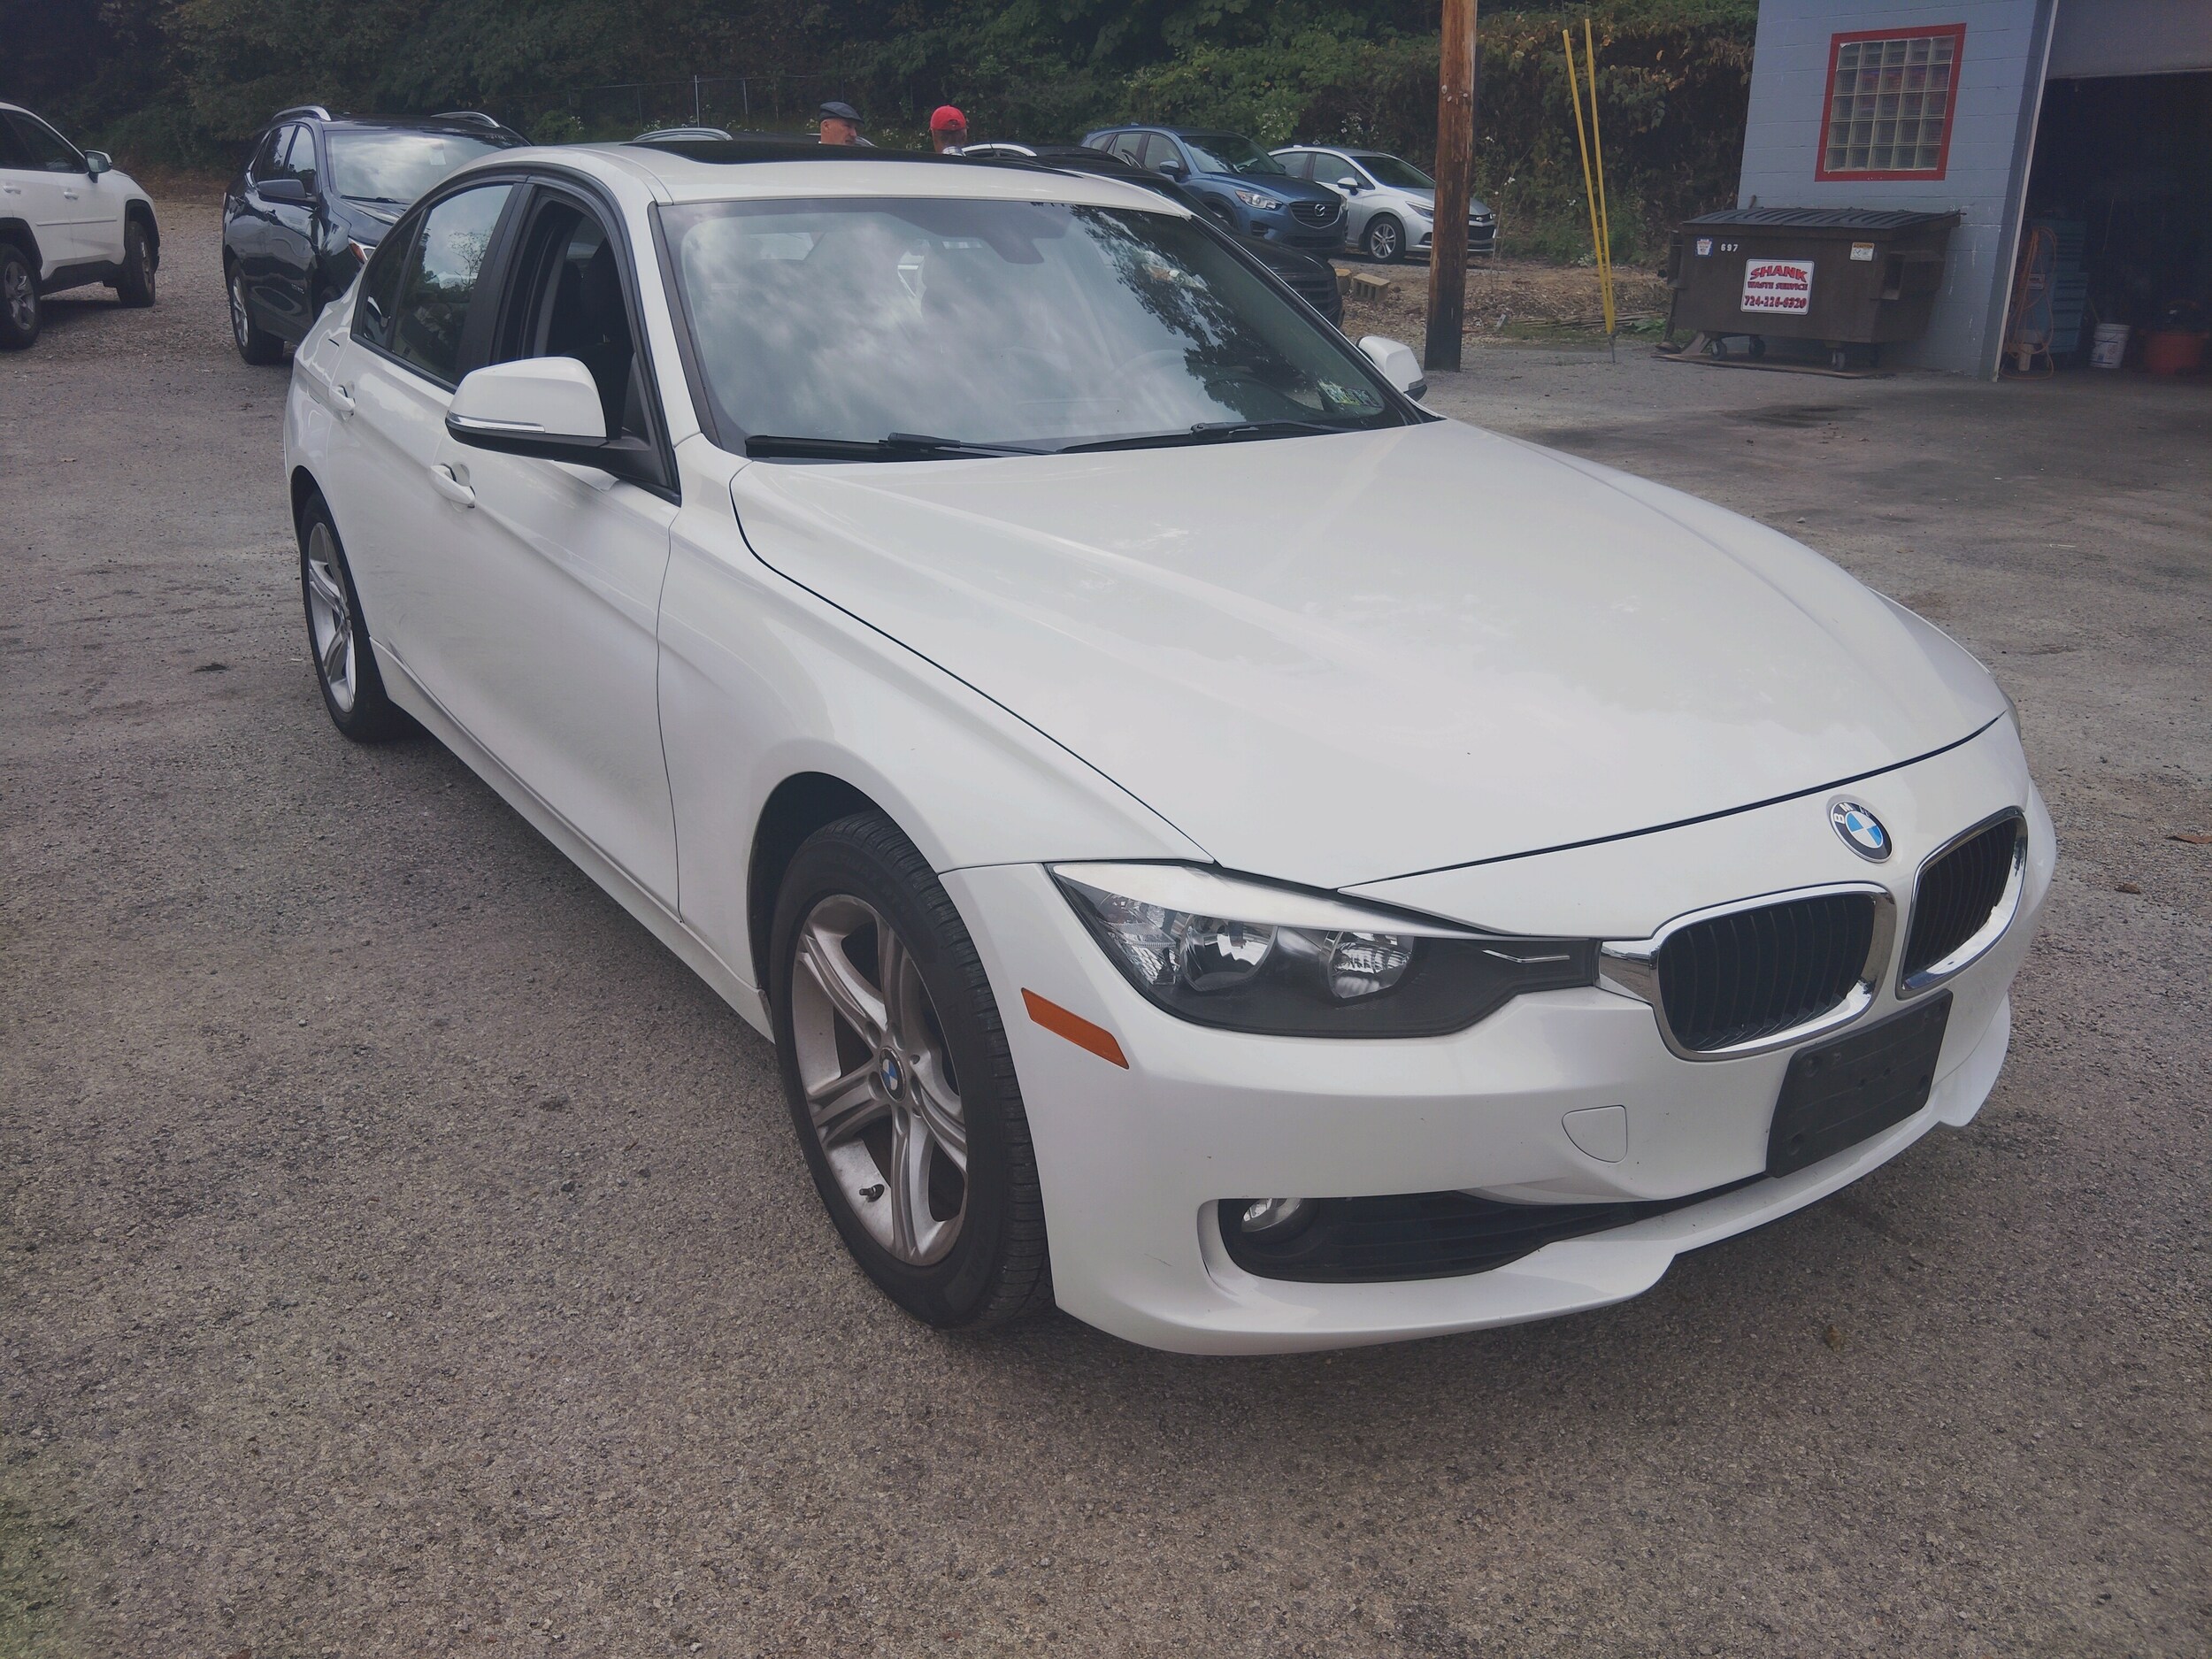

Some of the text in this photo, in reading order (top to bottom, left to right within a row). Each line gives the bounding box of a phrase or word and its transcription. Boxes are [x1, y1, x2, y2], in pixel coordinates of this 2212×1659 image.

[1720, 243, 1739, 252] 697
[1749, 265, 1808, 282] SHANK
[1775, 282, 1808, 291] SERVICE
